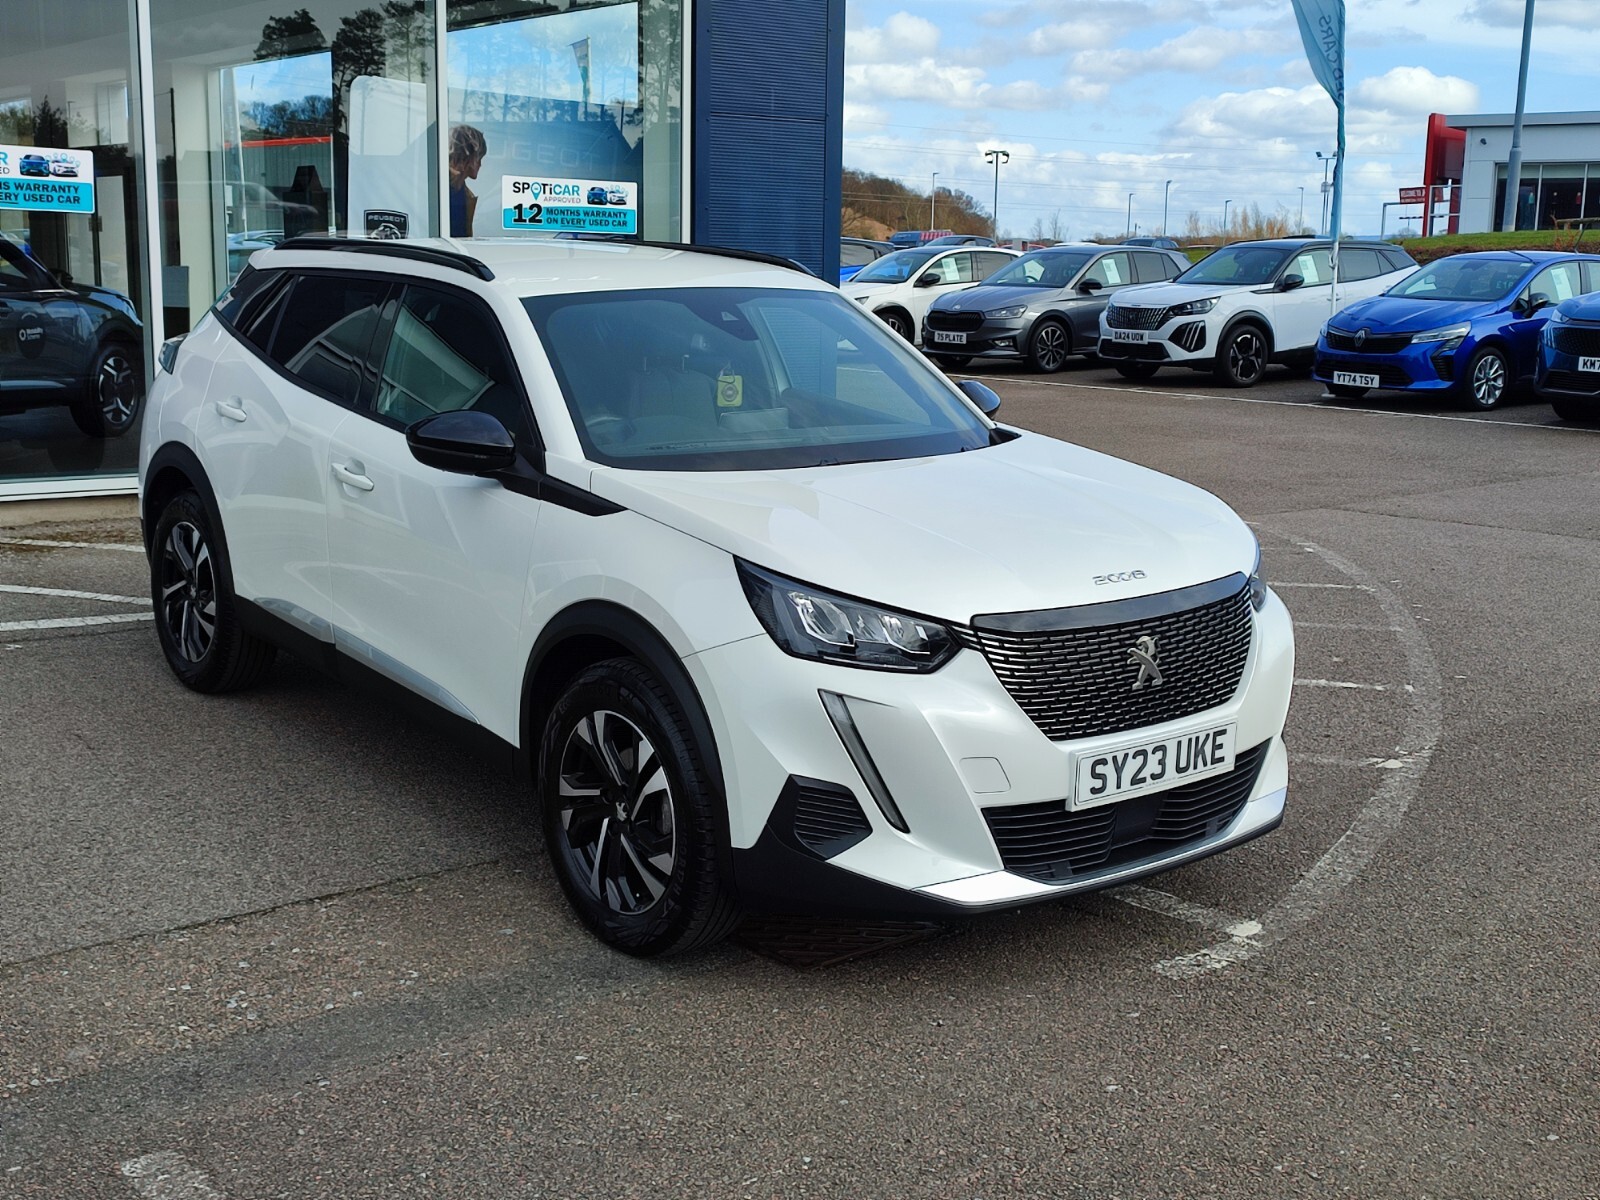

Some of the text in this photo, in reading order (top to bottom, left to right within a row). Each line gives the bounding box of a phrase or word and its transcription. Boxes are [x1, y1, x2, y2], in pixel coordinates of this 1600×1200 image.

[14, 183, 80, 194] WARRANTY
[23, 194, 54, 203] USED
[57, 196, 81, 204] CAR
[543, 196, 581, 204] APPROVED
[368, 214, 405, 223] PEUGEOT
[513, 203, 627, 224] 12 MONTHS WARRANTY
[560, 218, 586, 228] EVERY
[588, 219, 610, 227] USED
[936, 332, 964, 342] 75 PLATE
[1337, 373, 1375, 385] YT74 TSY
[1092, 570, 1147, 585] 2008
[1090, 728, 1228, 796] SY23 UKE
